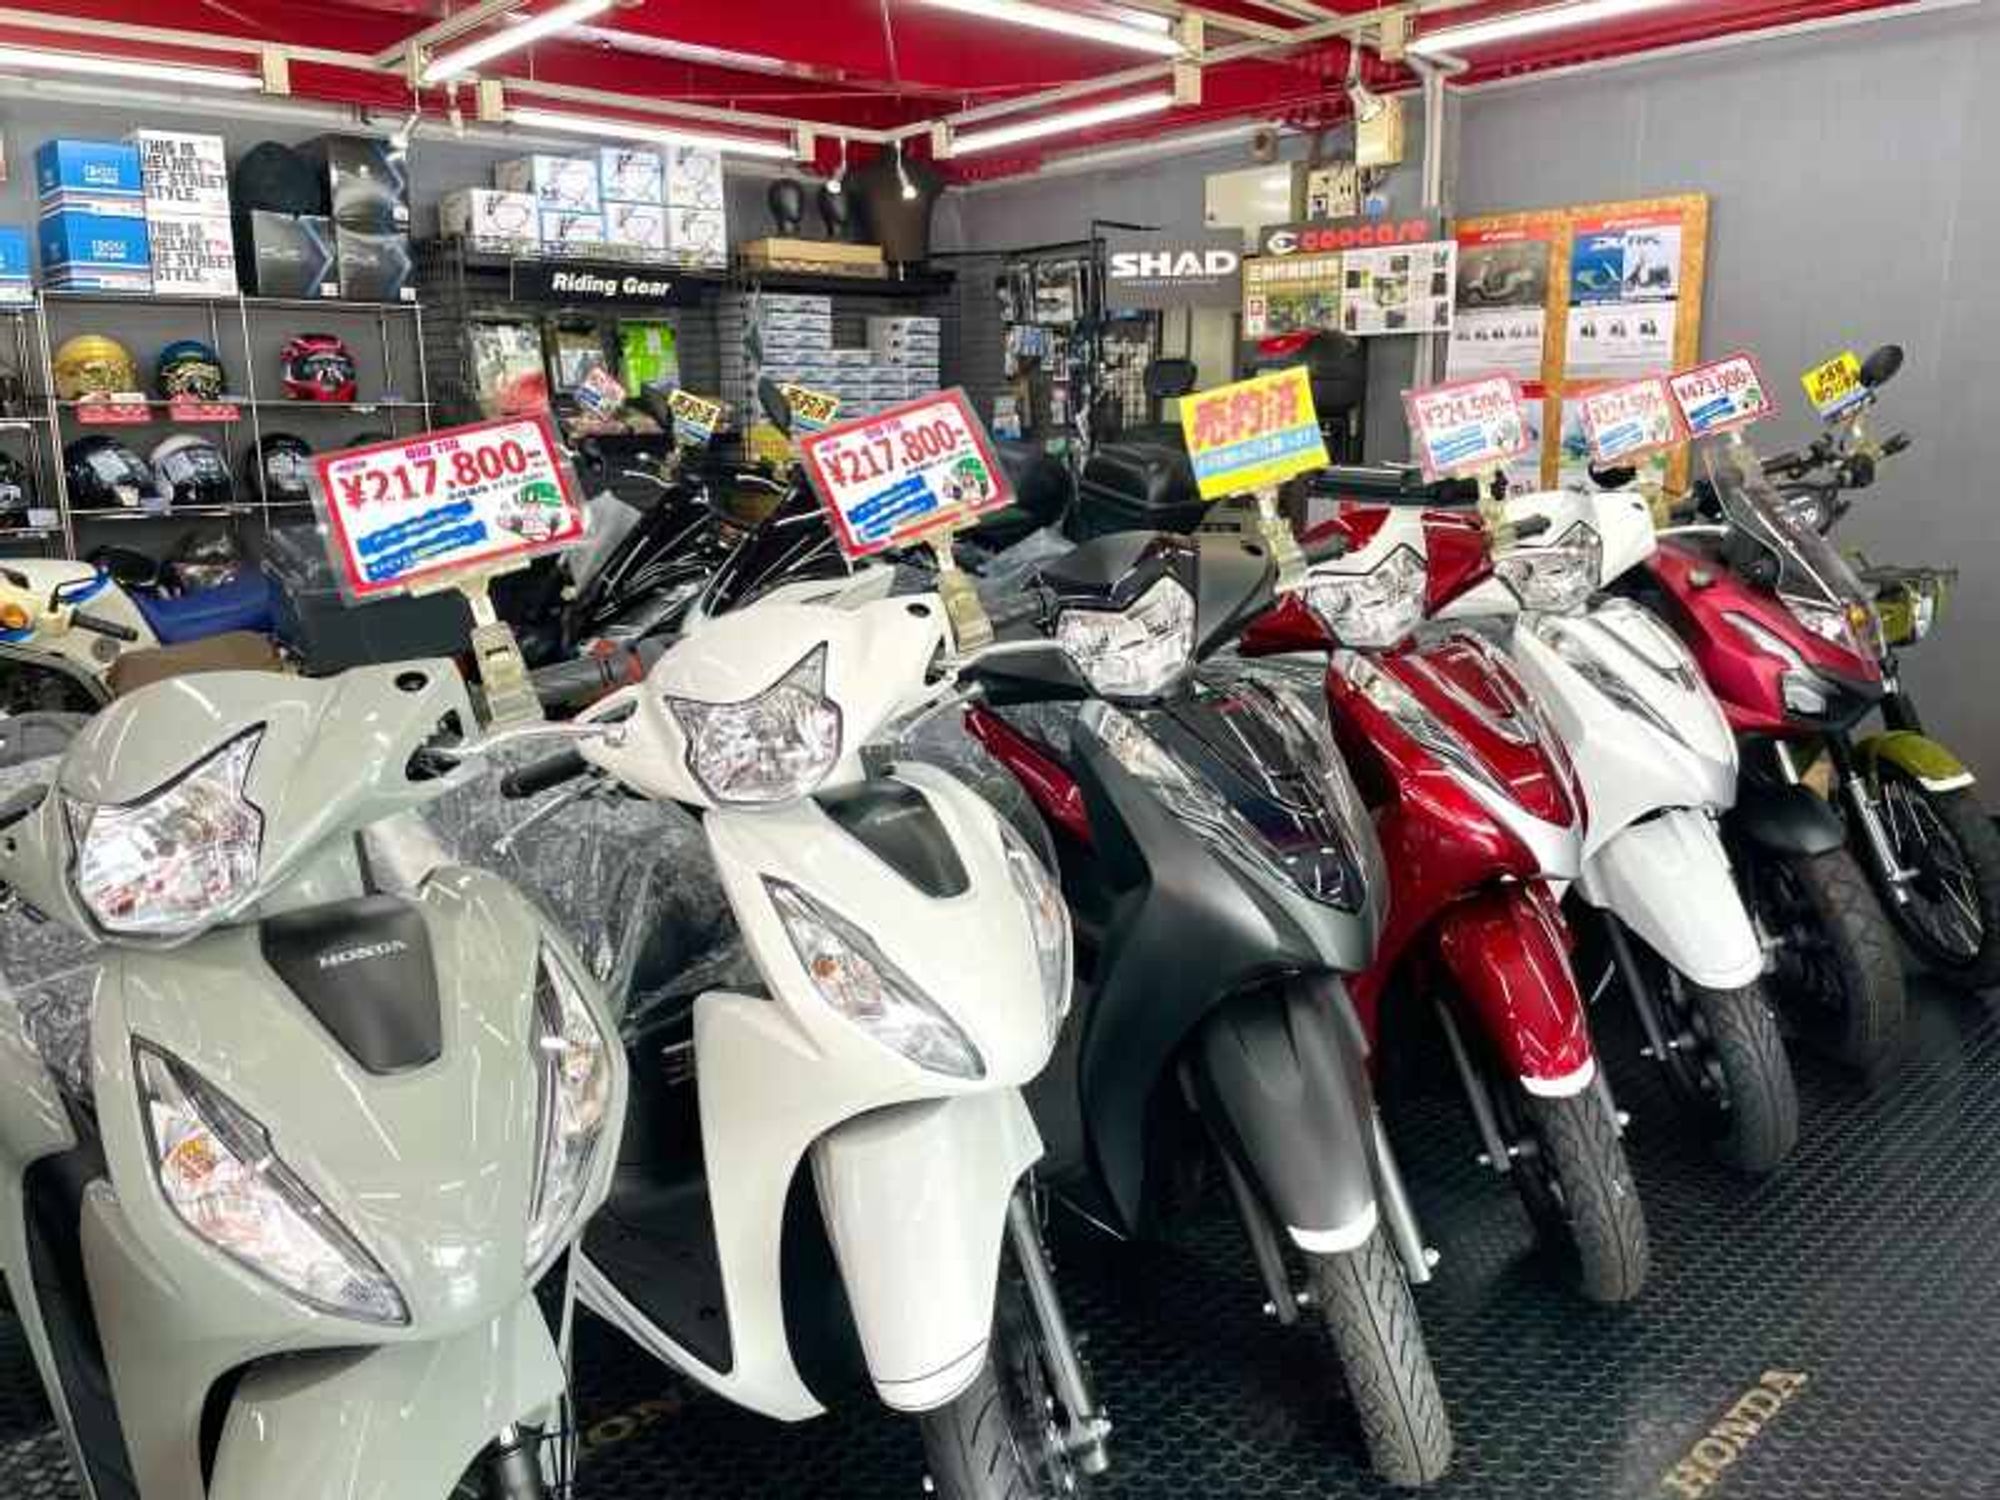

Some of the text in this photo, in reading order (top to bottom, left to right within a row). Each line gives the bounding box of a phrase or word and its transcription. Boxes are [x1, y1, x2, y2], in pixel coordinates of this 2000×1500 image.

[170, 172, 224, 189] STREET
[1110, 250, 1238, 278] SHAD
[551, 271, 671, 297] Riding Gear
[319, 939, 408, 970] HONDA
[1660, 1370, 1809, 1498] HONDA
